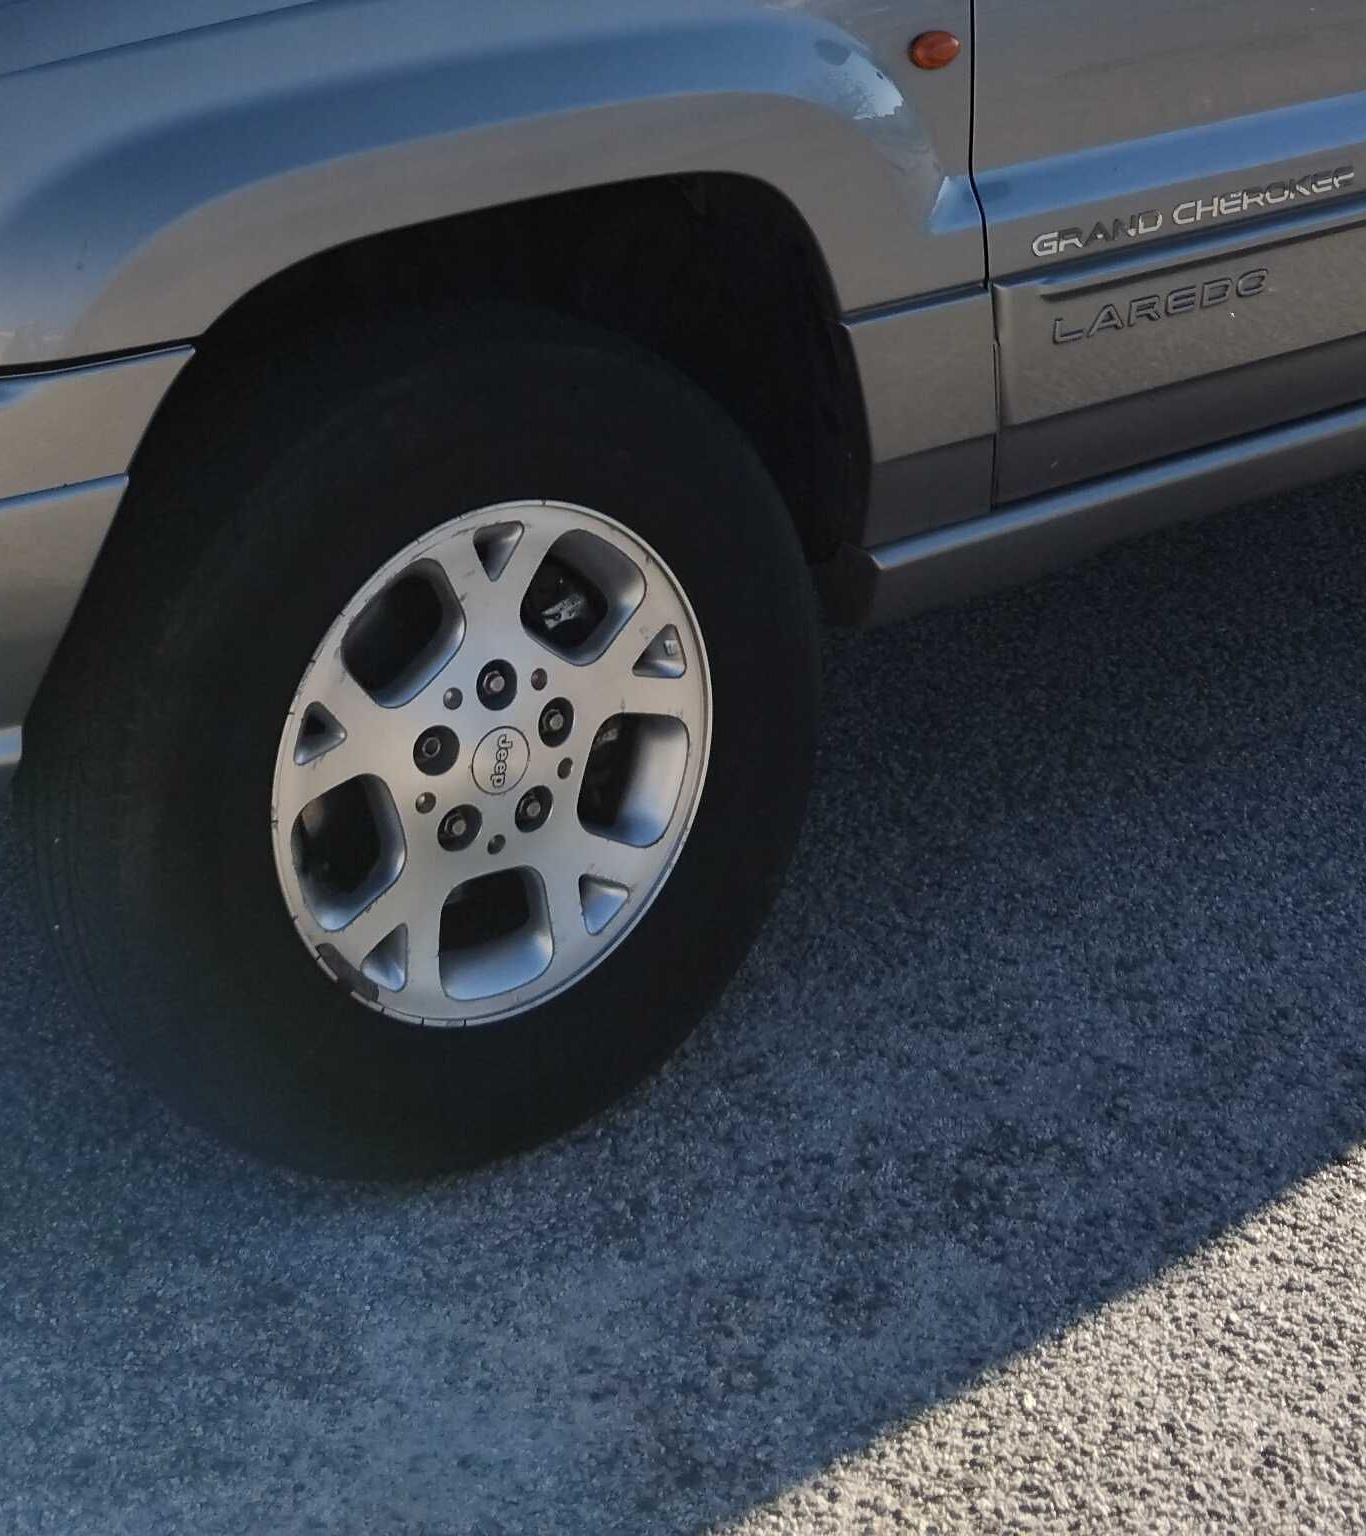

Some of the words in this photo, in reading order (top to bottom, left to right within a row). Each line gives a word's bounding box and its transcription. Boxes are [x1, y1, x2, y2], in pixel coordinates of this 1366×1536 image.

[1031, 209, 1164, 257] GRAND
[1171, 165, 1356, 226] CHEROKEE
[1052, 267, 1270, 345] LAREDO
[490, 733, 514, 789] Jeep
